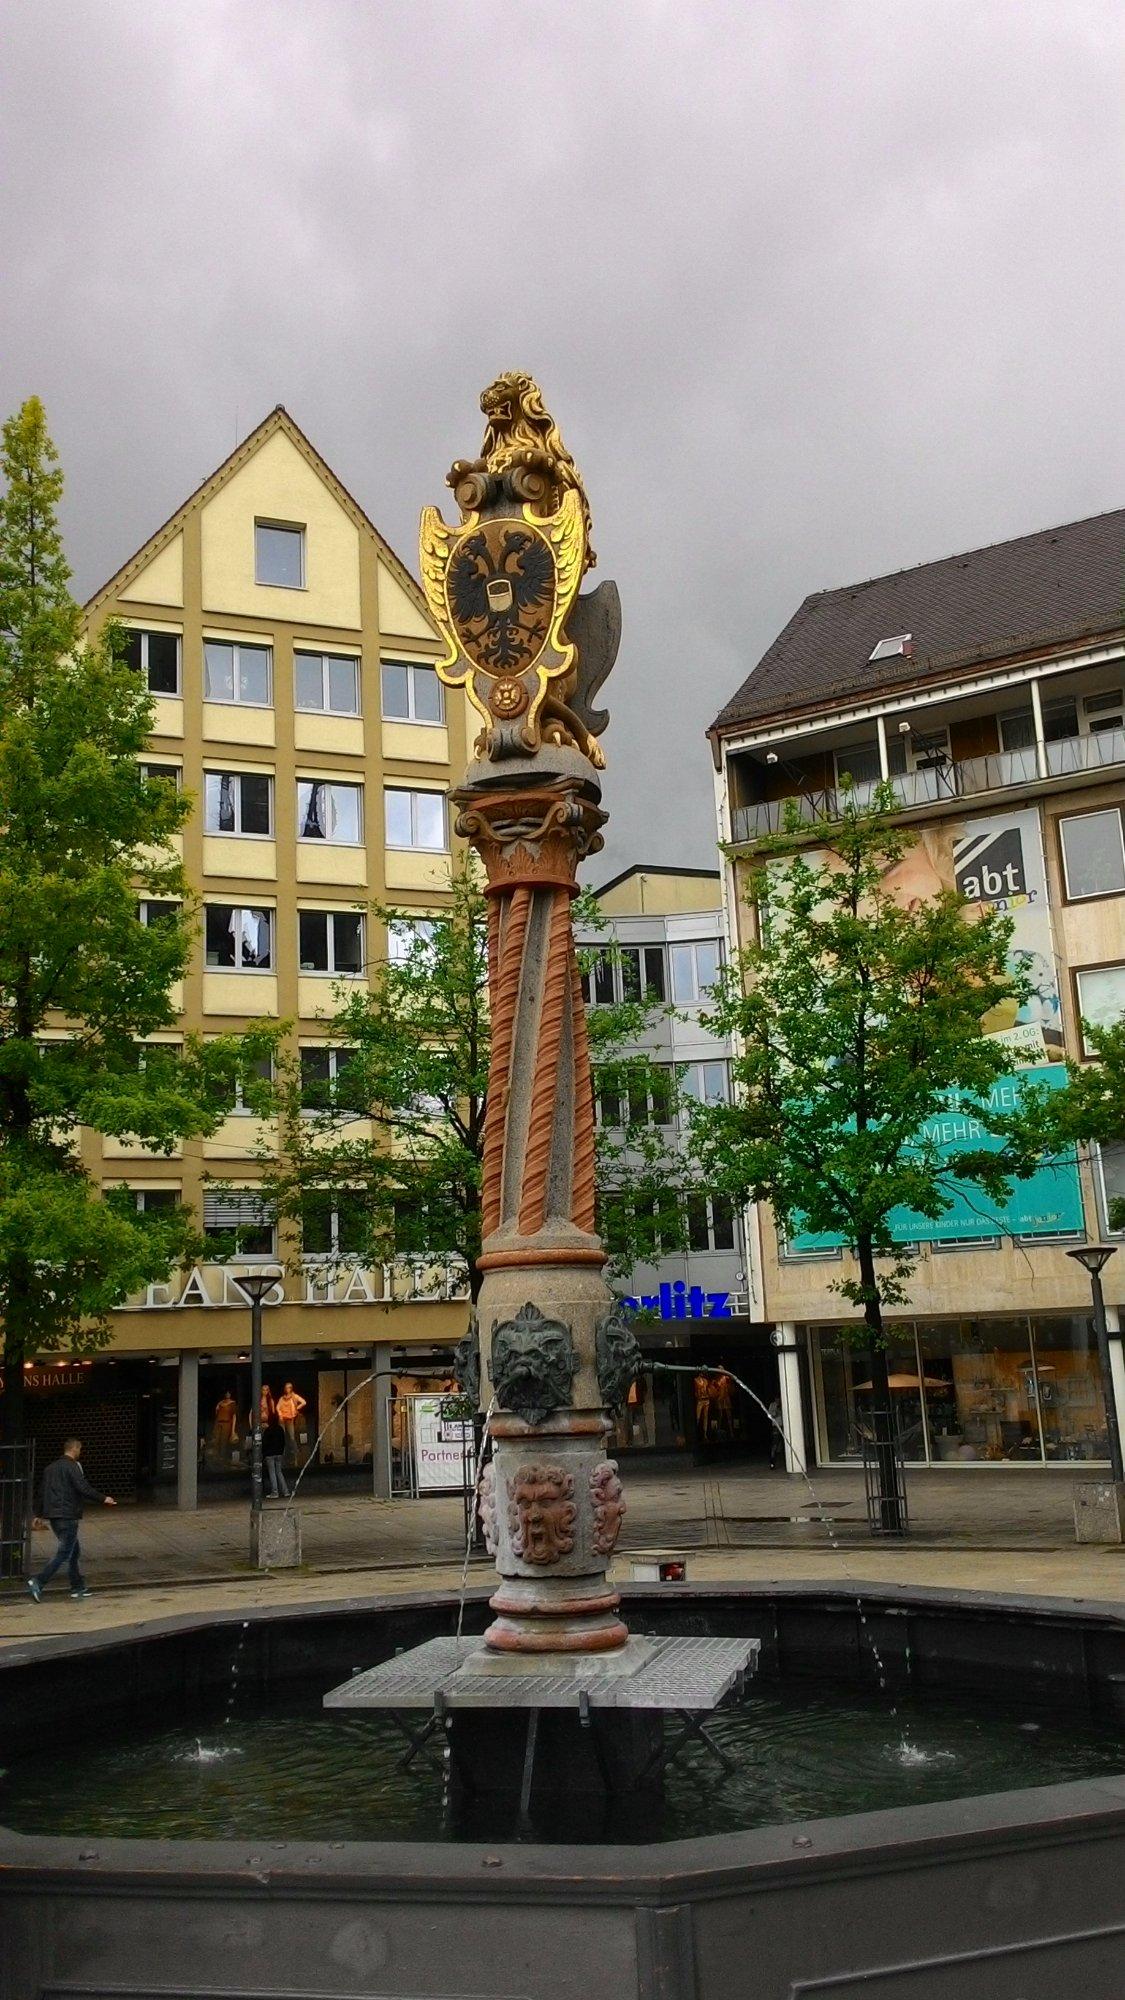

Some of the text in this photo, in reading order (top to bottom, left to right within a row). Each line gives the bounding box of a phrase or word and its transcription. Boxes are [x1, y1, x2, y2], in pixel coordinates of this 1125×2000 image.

[963, 863, 1020, 899] abt
[980, 1086, 1021, 1109] MEH
[923, 1120, 982, 1143] MEHR
[145, 1265, 287, 1307] EANS
[618, 1280, 733, 1321] erlitz
[42, 1372, 86, 1386] HALLE
